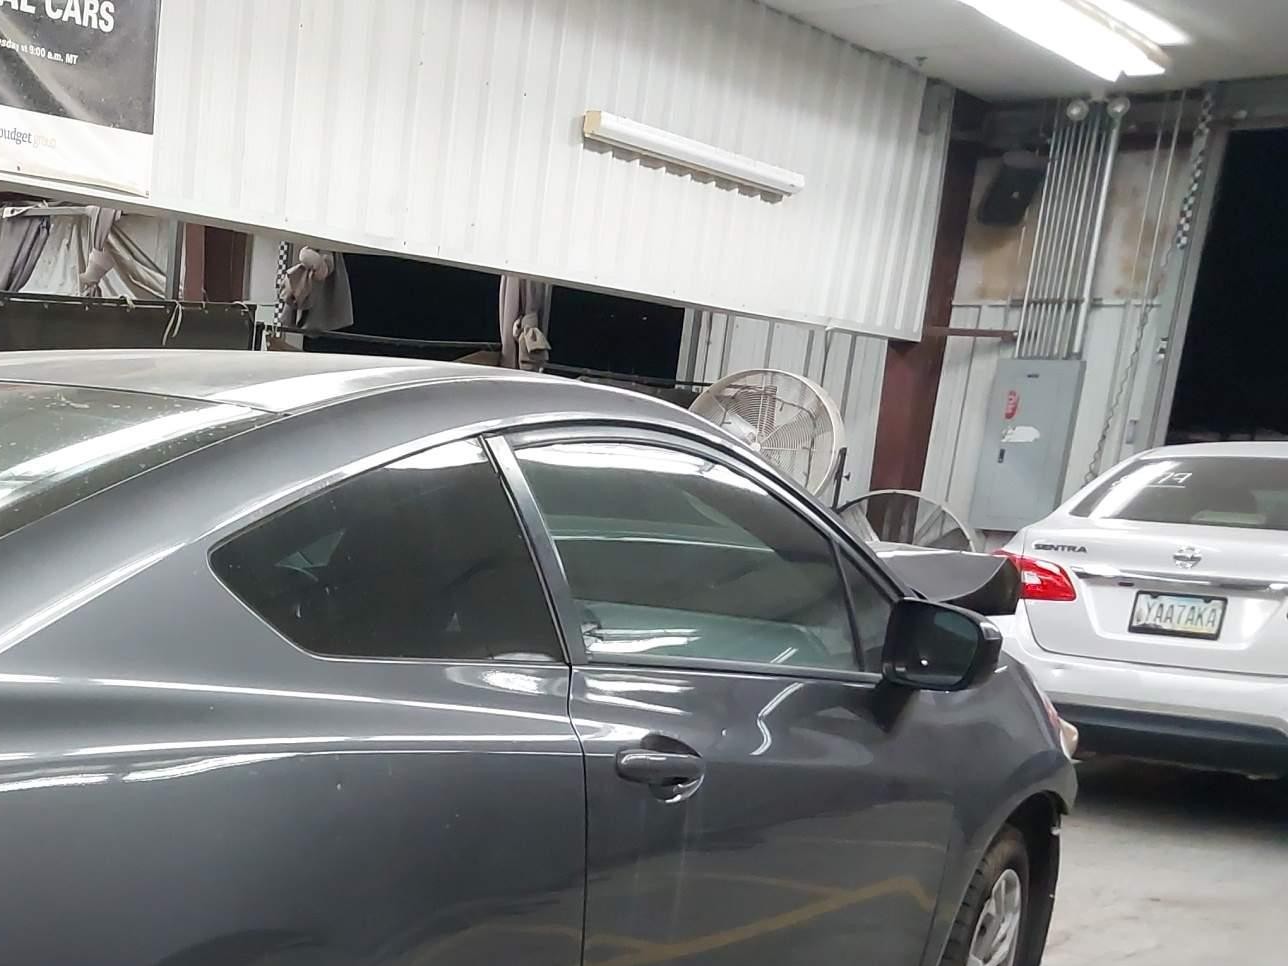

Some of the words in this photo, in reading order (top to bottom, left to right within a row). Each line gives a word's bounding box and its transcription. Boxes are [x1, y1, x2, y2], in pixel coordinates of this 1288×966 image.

[45, 0, 115, 33] CARS
[29, 46, 46, 58] 9:00
[65, 53, 78, 65] MT
[1033, 543, 1088, 553] SENTRA
